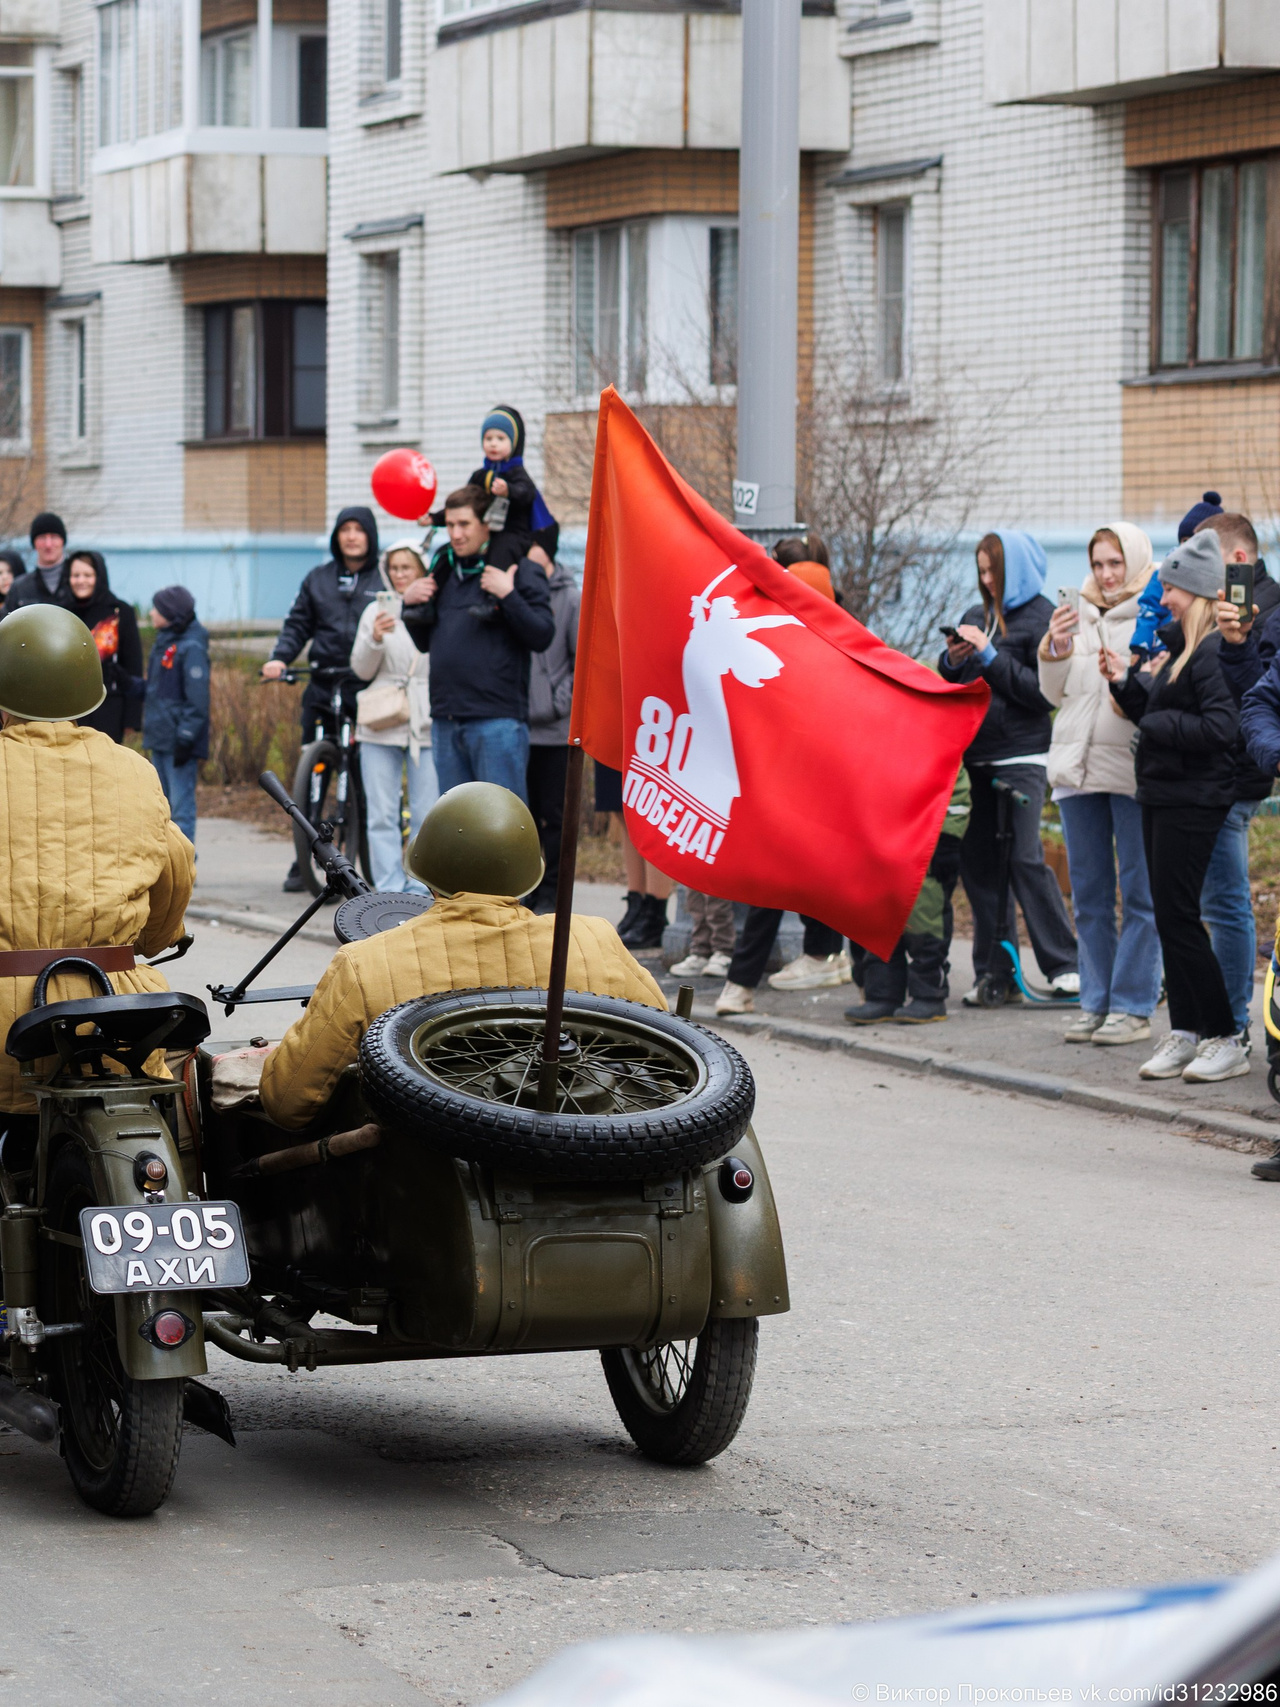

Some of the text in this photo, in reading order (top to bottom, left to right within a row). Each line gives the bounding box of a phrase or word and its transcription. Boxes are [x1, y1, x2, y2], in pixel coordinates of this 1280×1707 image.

[634, 695, 698, 776] 80
[622, 769, 726, 865] ПОБЕДА!
[90, 1207, 235, 1255] 09-05
[126, 1256, 217, 1287] АХИ
